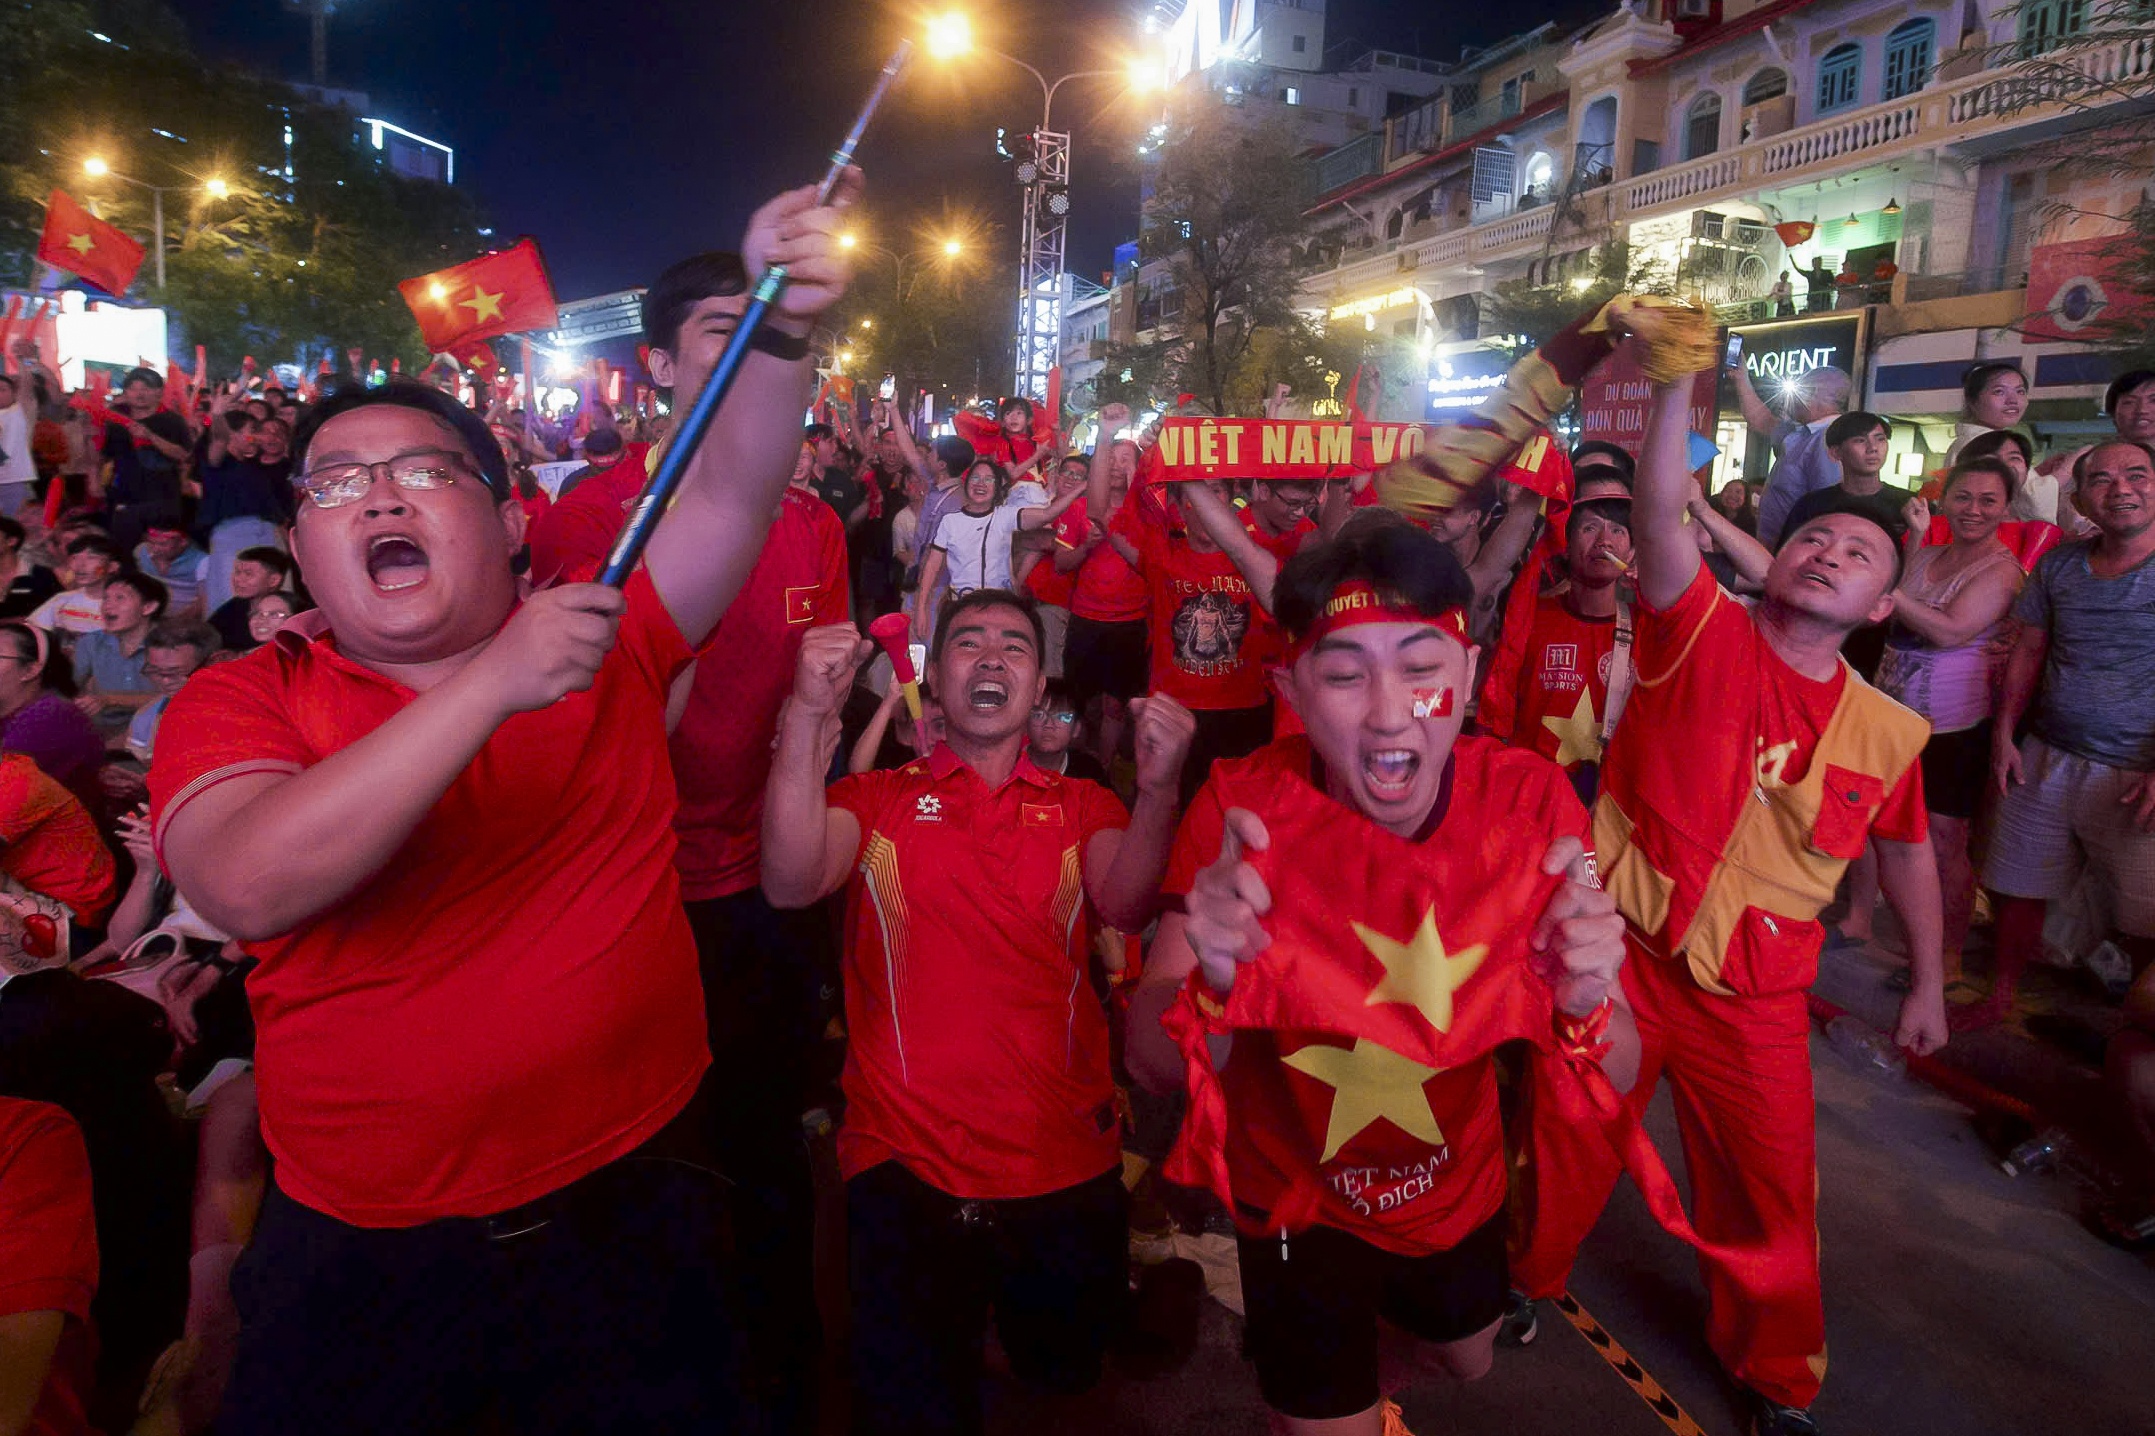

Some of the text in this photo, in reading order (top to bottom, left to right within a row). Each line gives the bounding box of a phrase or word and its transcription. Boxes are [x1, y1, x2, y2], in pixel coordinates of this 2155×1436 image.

[1158, 418, 1244, 473] VIỆT
[1262, 425, 1353, 465] NAM
[1389, 1145, 1448, 1179] NAM
